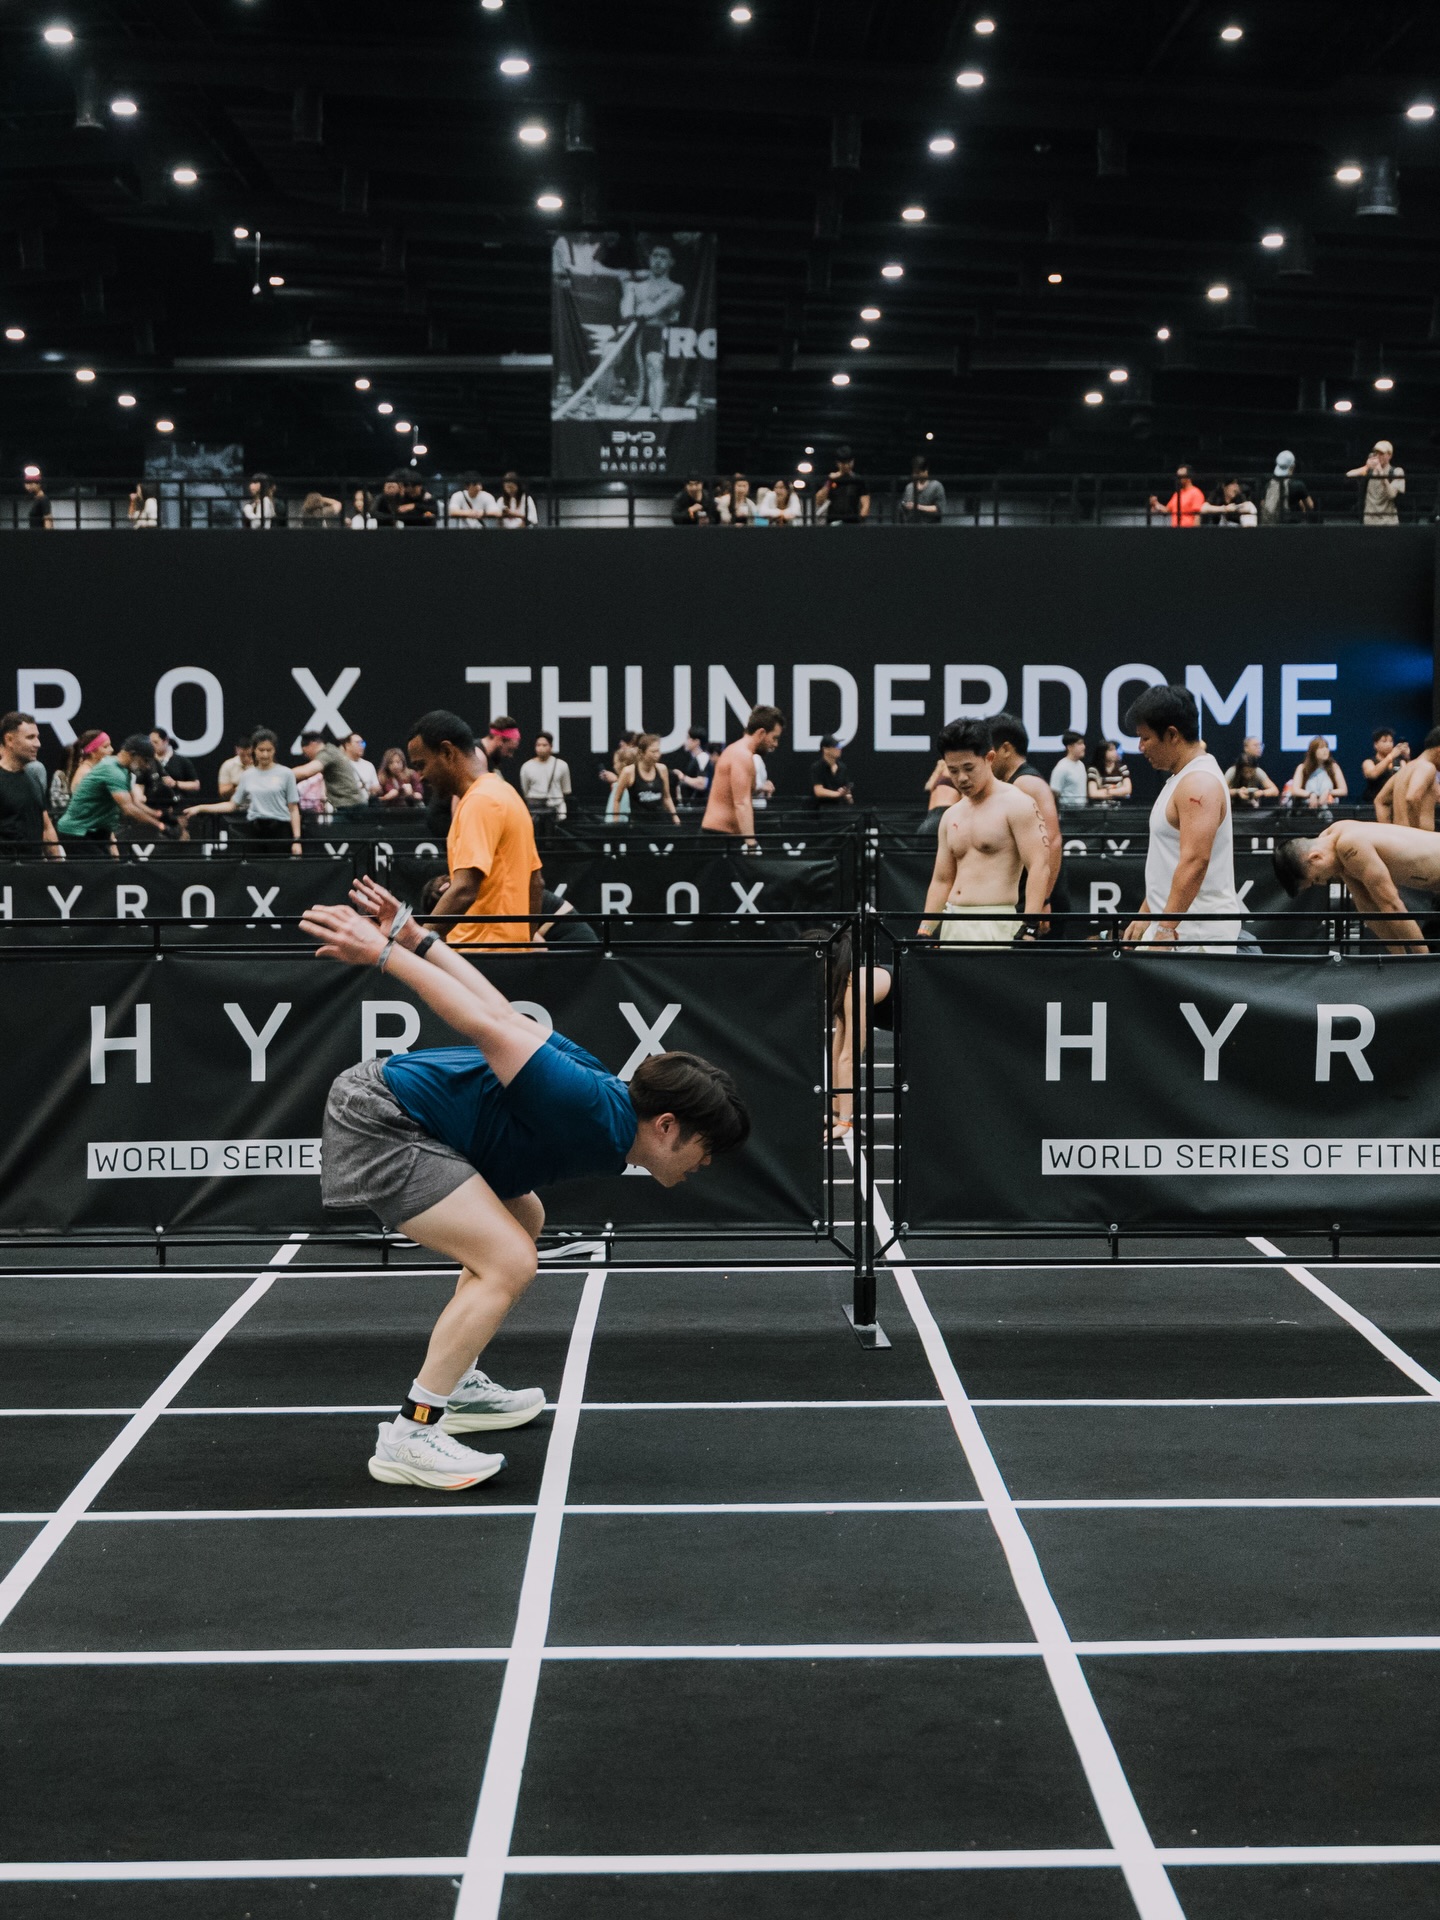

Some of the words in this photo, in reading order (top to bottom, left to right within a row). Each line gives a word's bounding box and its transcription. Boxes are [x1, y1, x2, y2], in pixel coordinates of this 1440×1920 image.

[662, 327, 717, 359] RO
[612, 431, 656, 443] BYD
[600, 446, 666, 458] HYROX
[600, 461, 666, 472] BANGKOK
[16, 666, 361, 758] ROX
[465, 664, 1338, 755] THUNDERDOME
[90, 1000, 682, 1084] HYRX
[1045, 1002, 1376, 1082] HYR
[95, 1147, 208, 1172] WORLD
[223, 1144, 323, 1169] SERIE
[1049, 1145, 1162, 1169] WORLD
[1176, 1144, 1289, 1169] SERIES
[1304, 1144, 1343, 1168] OF
